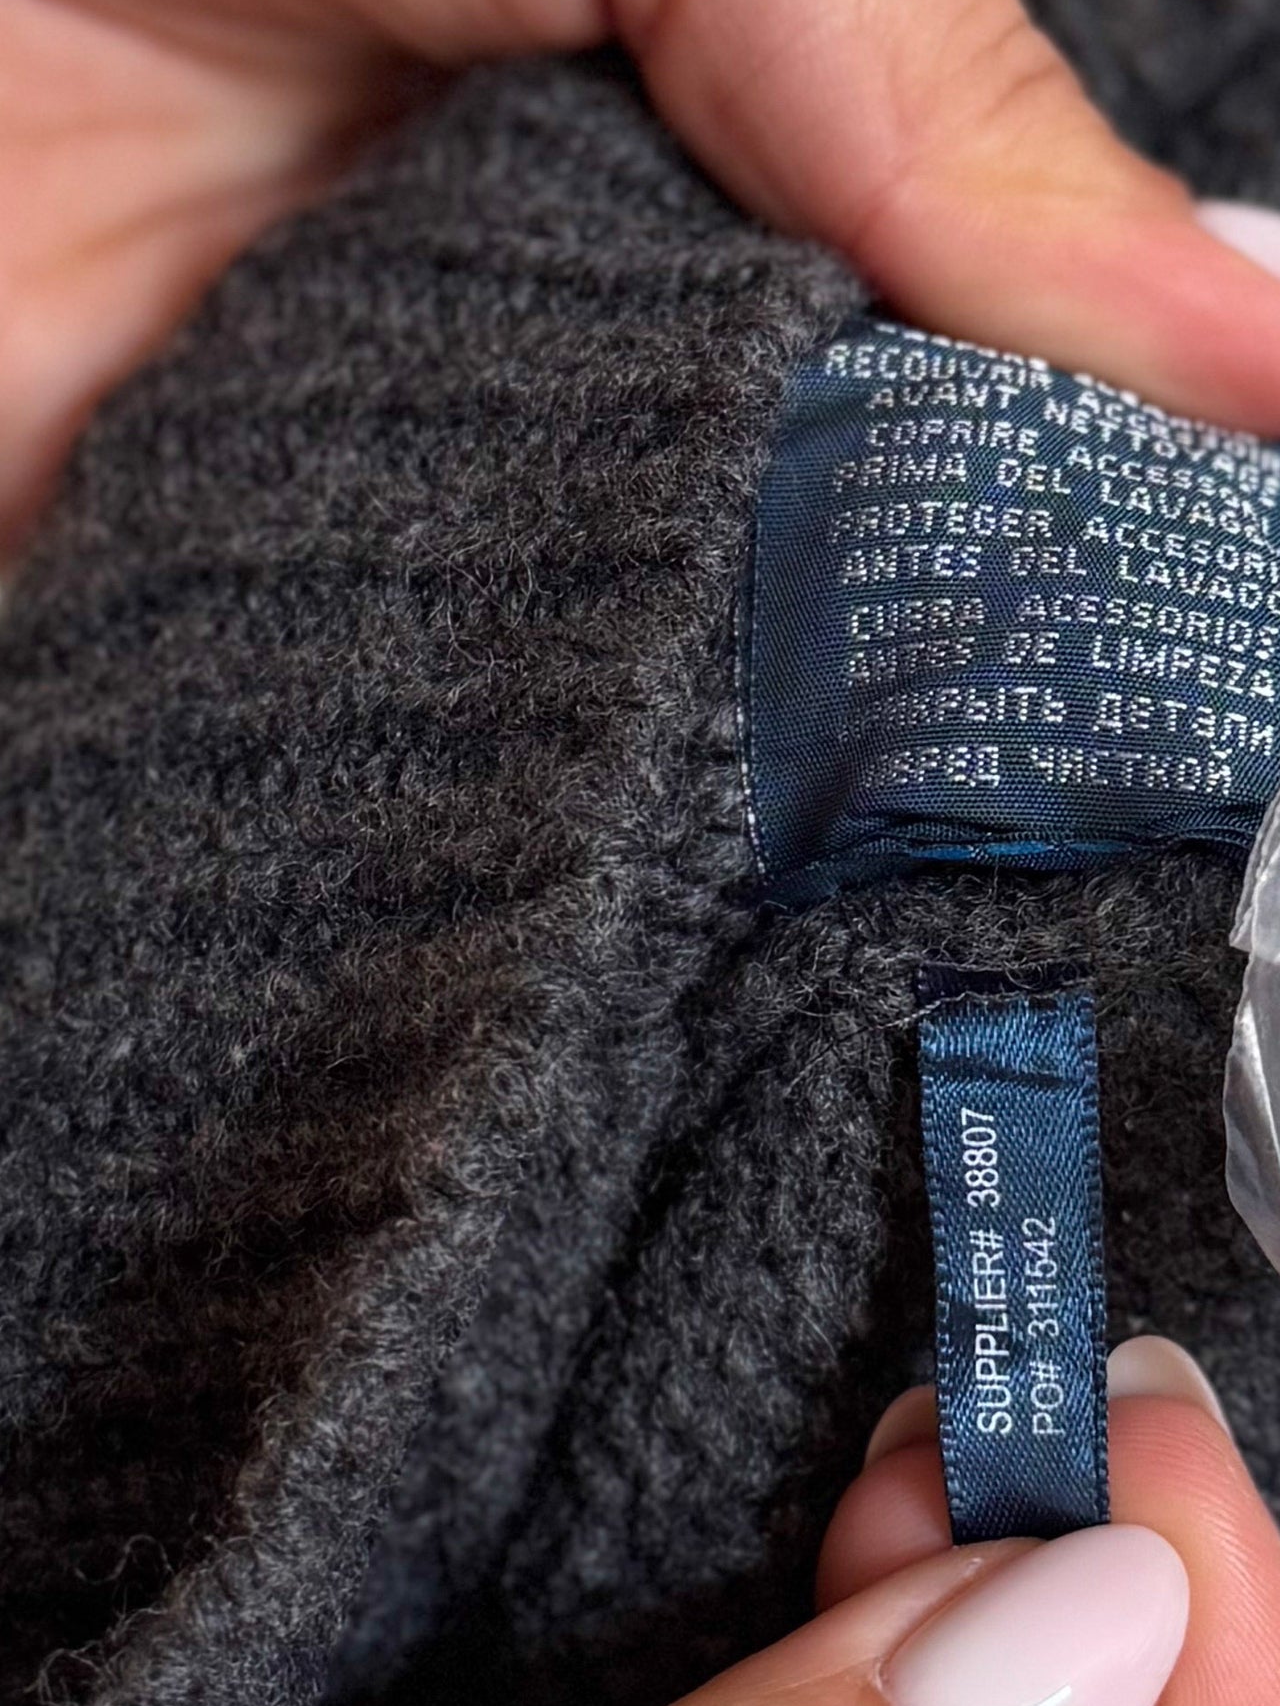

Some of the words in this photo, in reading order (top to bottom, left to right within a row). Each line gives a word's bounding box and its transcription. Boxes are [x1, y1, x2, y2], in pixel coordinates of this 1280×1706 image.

[825, 345, 1053, 391] RECOUVRIR
[869, 382, 1020, 410] AVANT
[1044, 397, 1280, 508] NETTOYAGE
[870, 419, 1039, 457] COPRIRE
[833, 452, 967, 492] PRIMA
[996, 458, 1072, 494] DEL
[831, 501, 1054, 542] PROTEGER
[842, 544, 982, 584] ANTES
[1009, 545, 1088, 577] DEL
[848, 598, 987, 641] CUBRA
[1020, 593, 1280, 659] ACESSORIOS
[847, 636, 975, 687] ANTES
[1002, 631, 1060, 664] DE
[1092, 634, 1276, 702] LIMPEZA
[1030, 742, 1231, 794] ЧИСТКОЙ
[961, 1107, 1001, 1209] 38807
[1022, 1216, 1058, 1337] 311542
[968, 1227, 1014, 1435] SUPPLIER#
[1031, 1360, 1065, 1435] PO#
